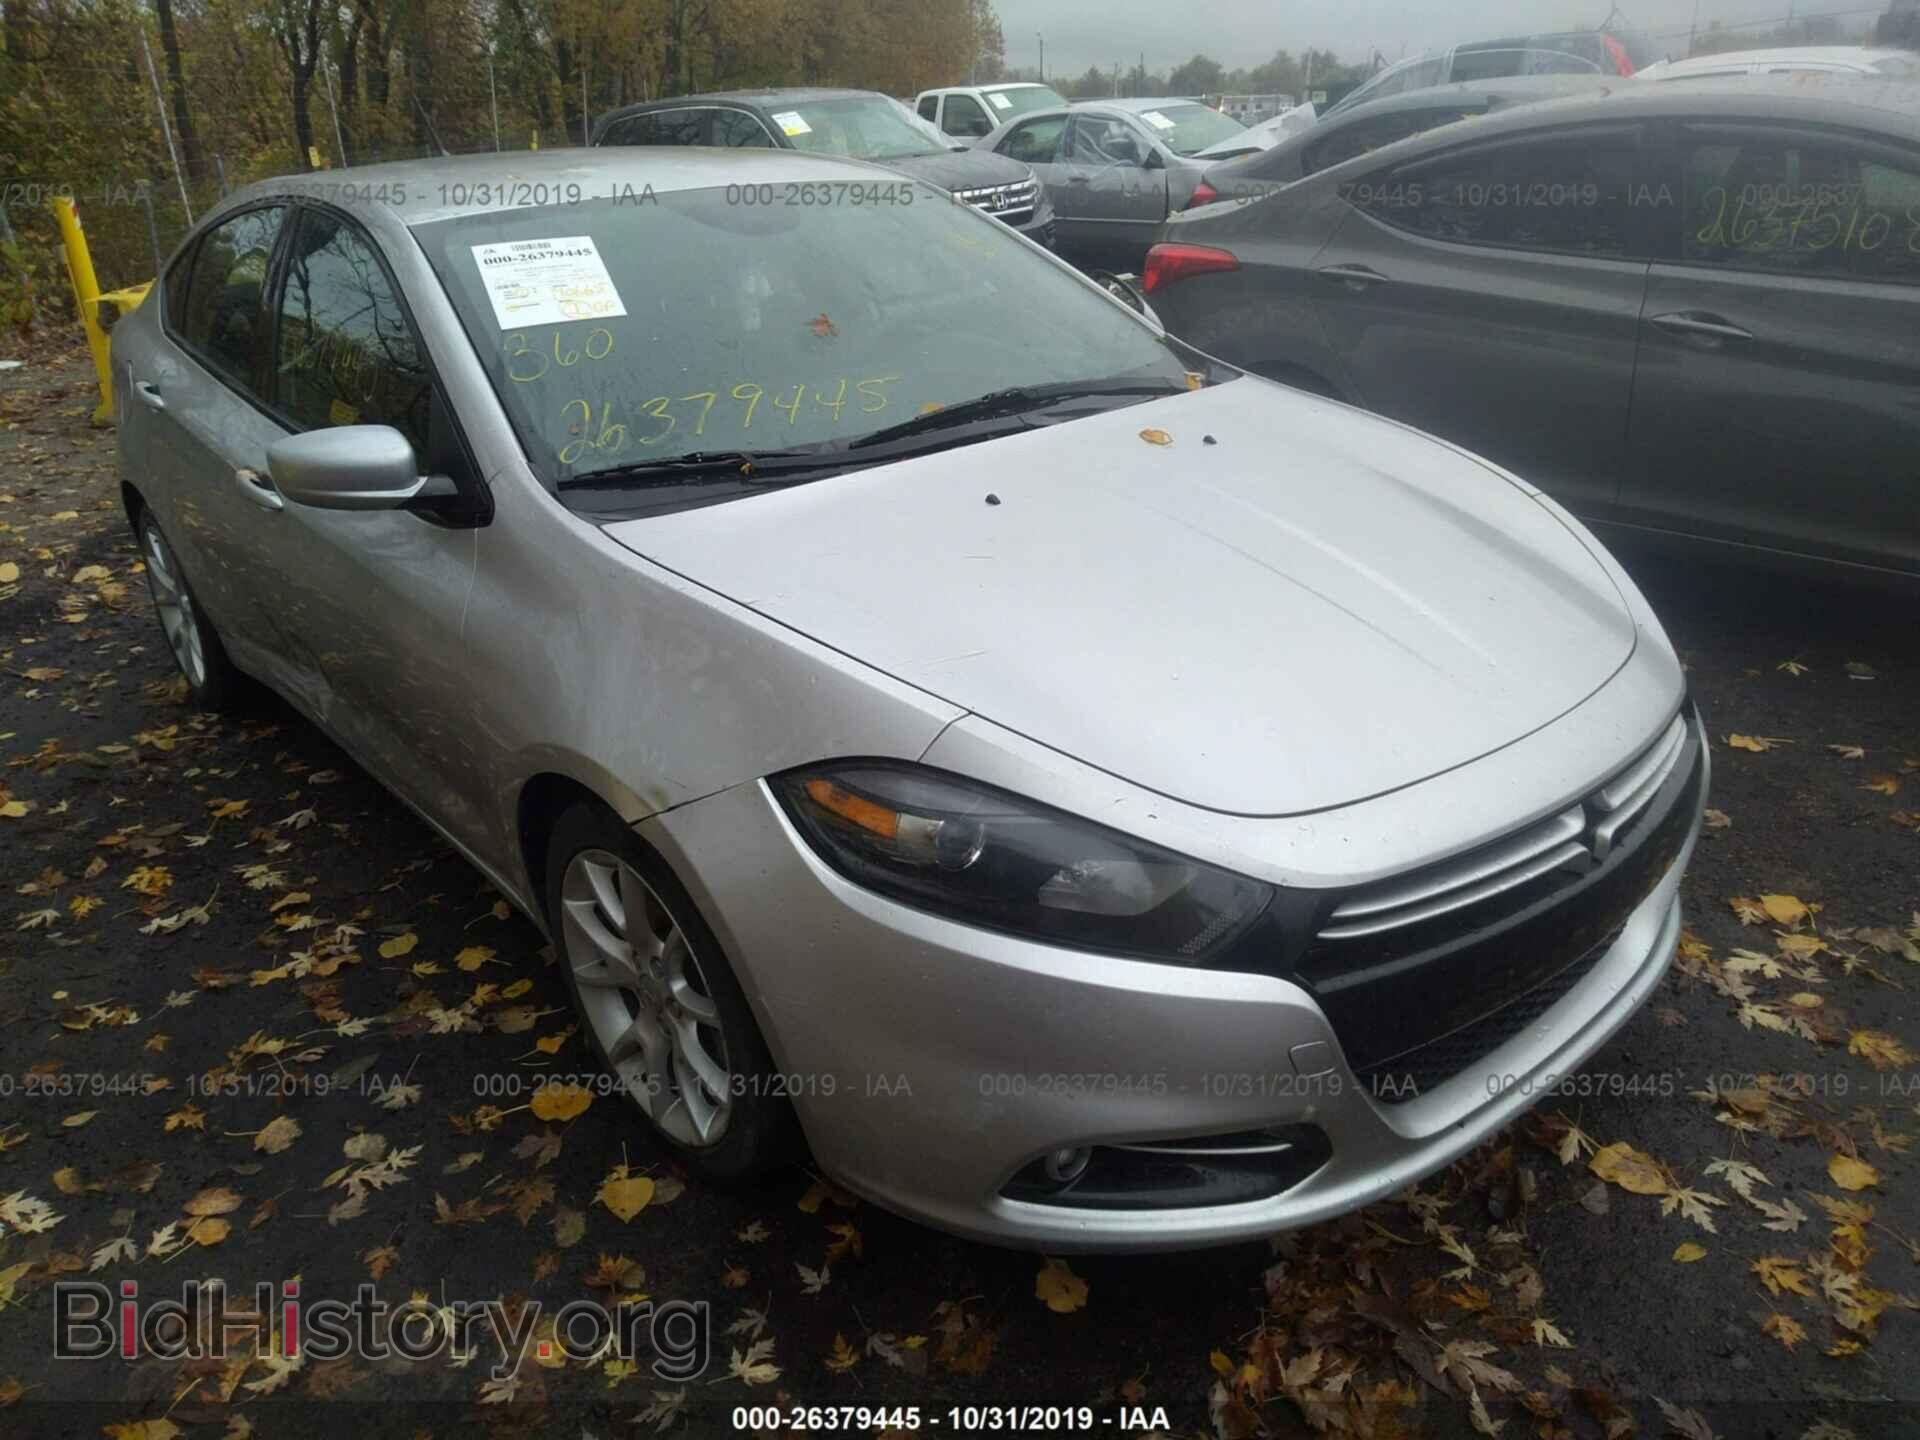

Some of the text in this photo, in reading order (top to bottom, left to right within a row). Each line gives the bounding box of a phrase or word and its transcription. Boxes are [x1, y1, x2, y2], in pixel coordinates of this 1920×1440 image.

[482, 248, 593, 265] 000-26379445
[503, 328, 614, 383] 360
[558, 376, 900, 464] 26379445
